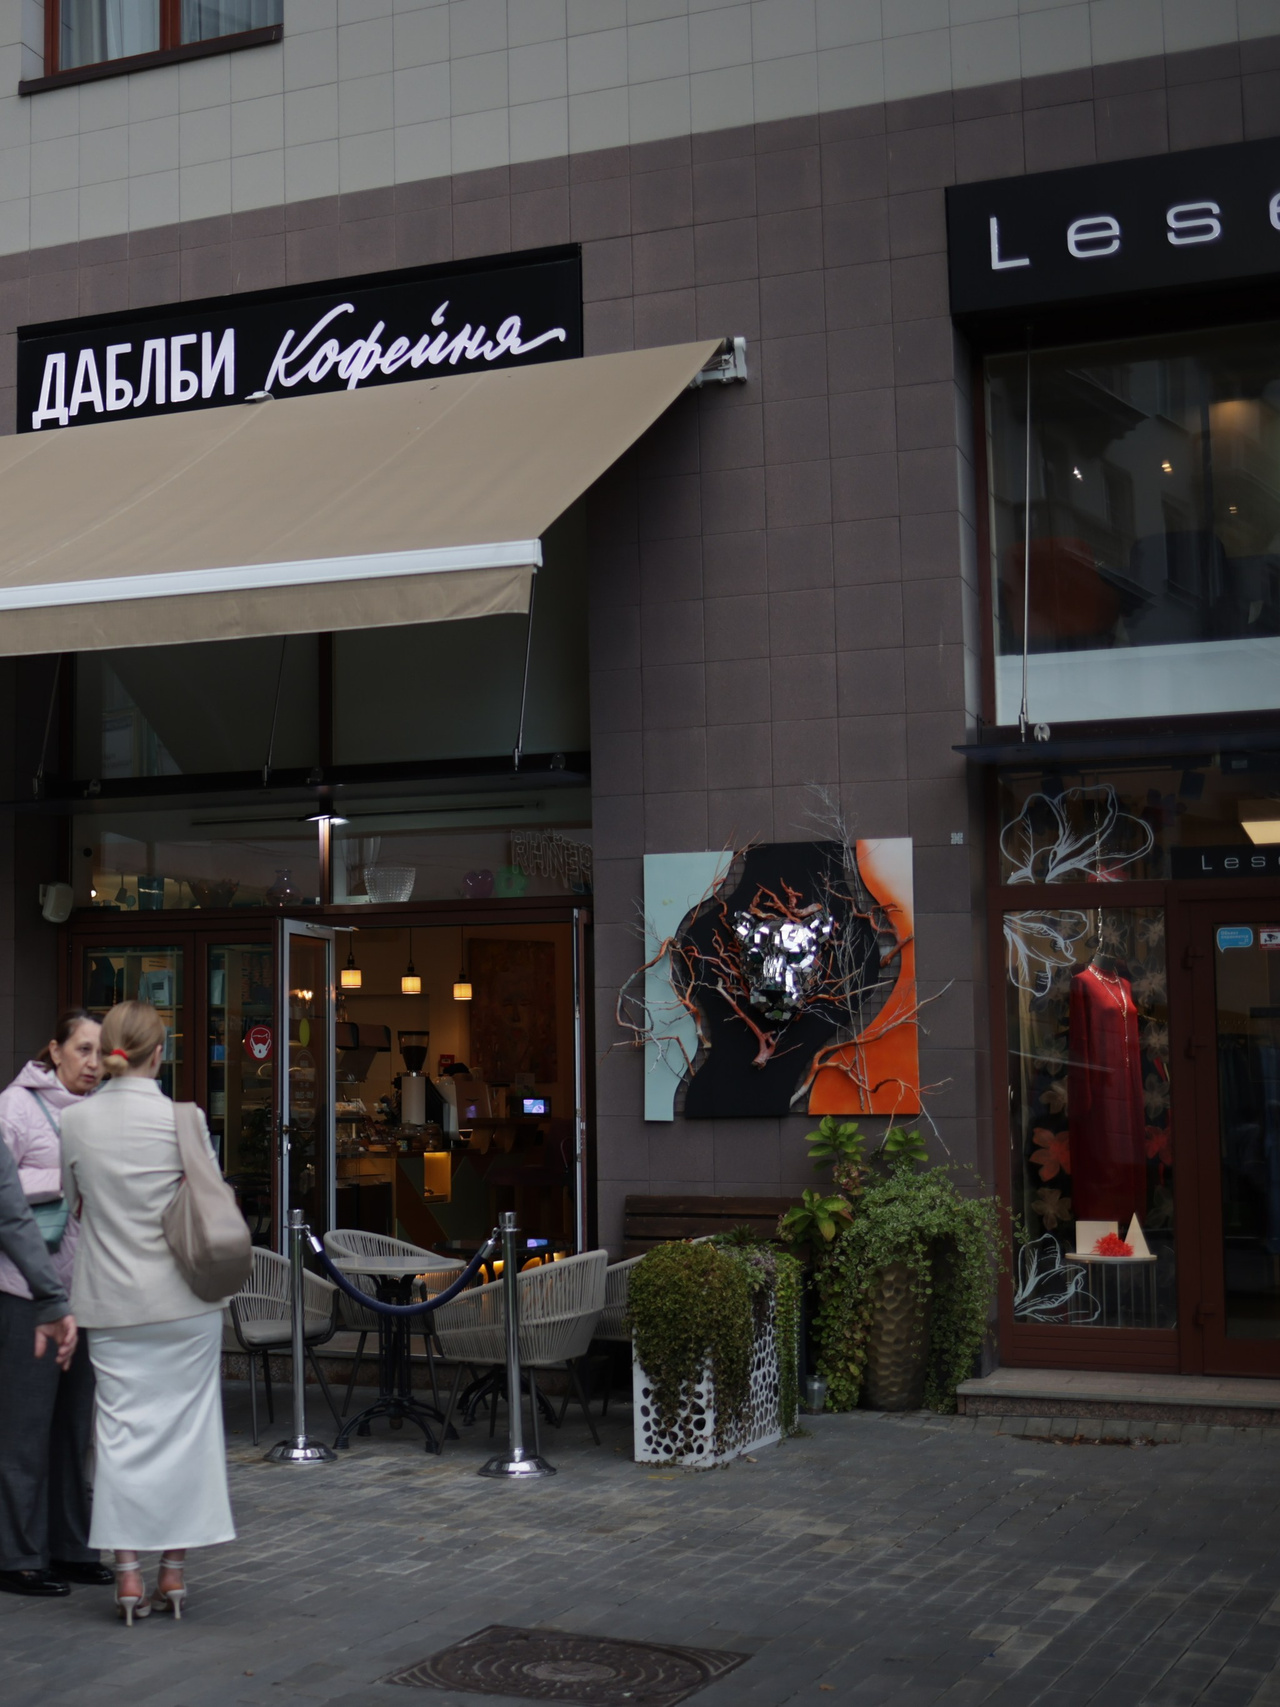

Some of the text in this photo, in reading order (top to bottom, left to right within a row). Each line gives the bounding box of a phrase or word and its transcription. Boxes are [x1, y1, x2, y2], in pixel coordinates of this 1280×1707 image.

[989, 192, 1280, 270] Les
[32, 300, 566, 429] ДАБЛБИ Кофейня
[1201, 854, 1280, 870] Les
